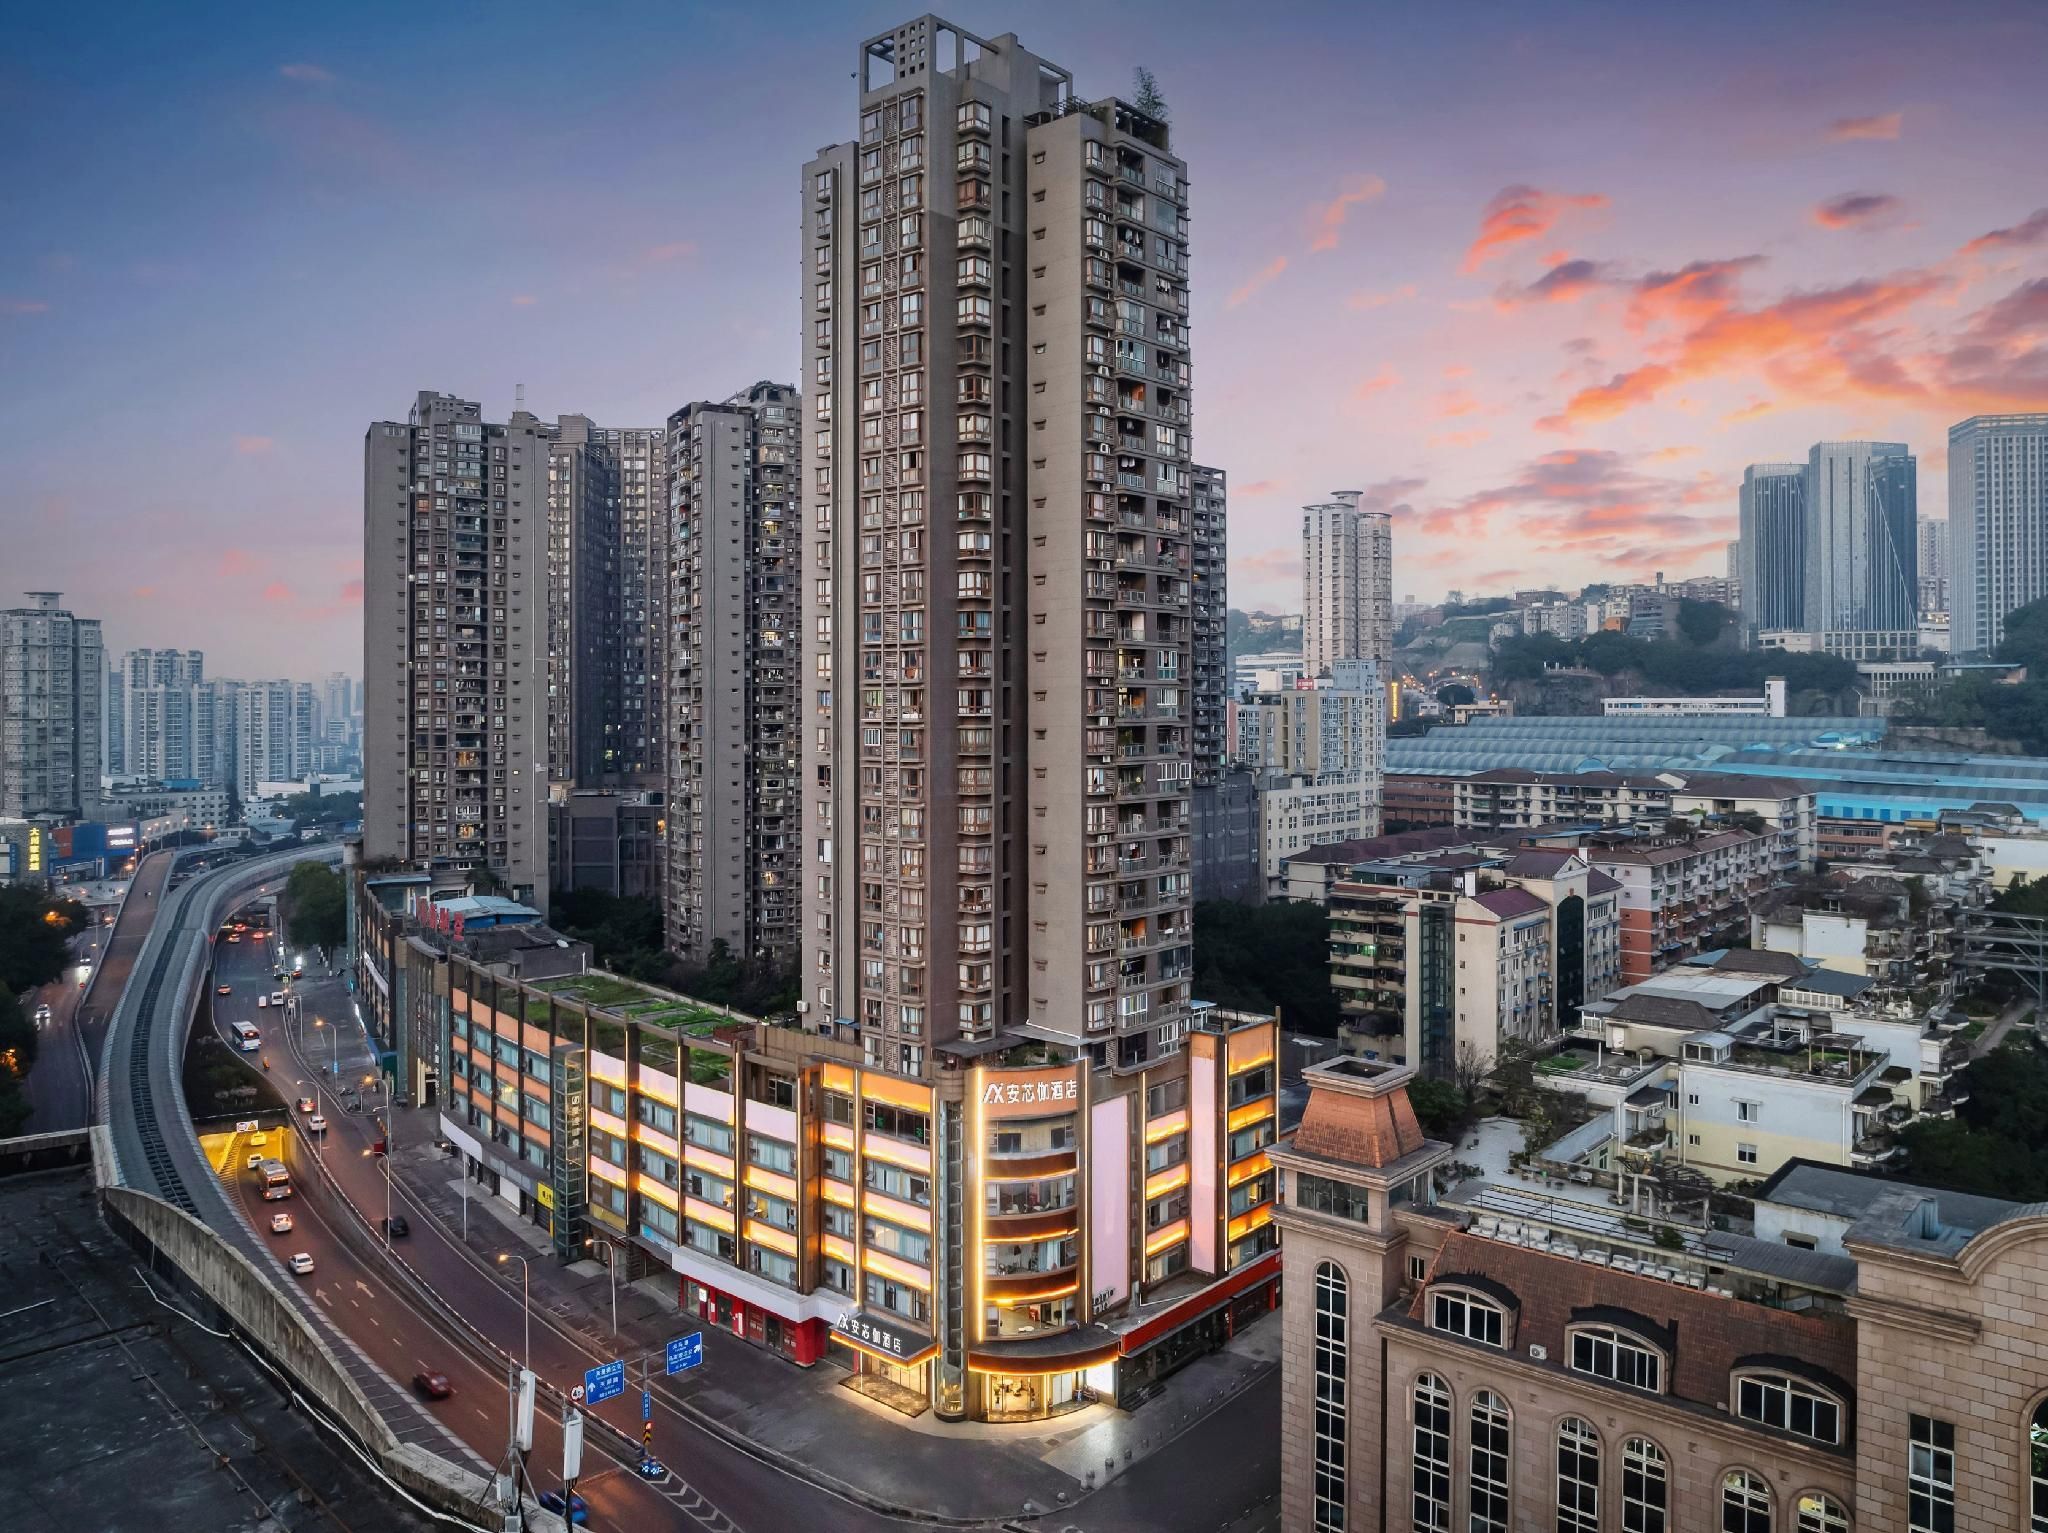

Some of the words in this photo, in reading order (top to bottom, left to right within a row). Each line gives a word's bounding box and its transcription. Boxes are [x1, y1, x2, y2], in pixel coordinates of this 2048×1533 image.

[1006, 1080, 1077, 1104] 安芯伽酒店
[851, 1319, 901, 1353] 安芯伽酒店
